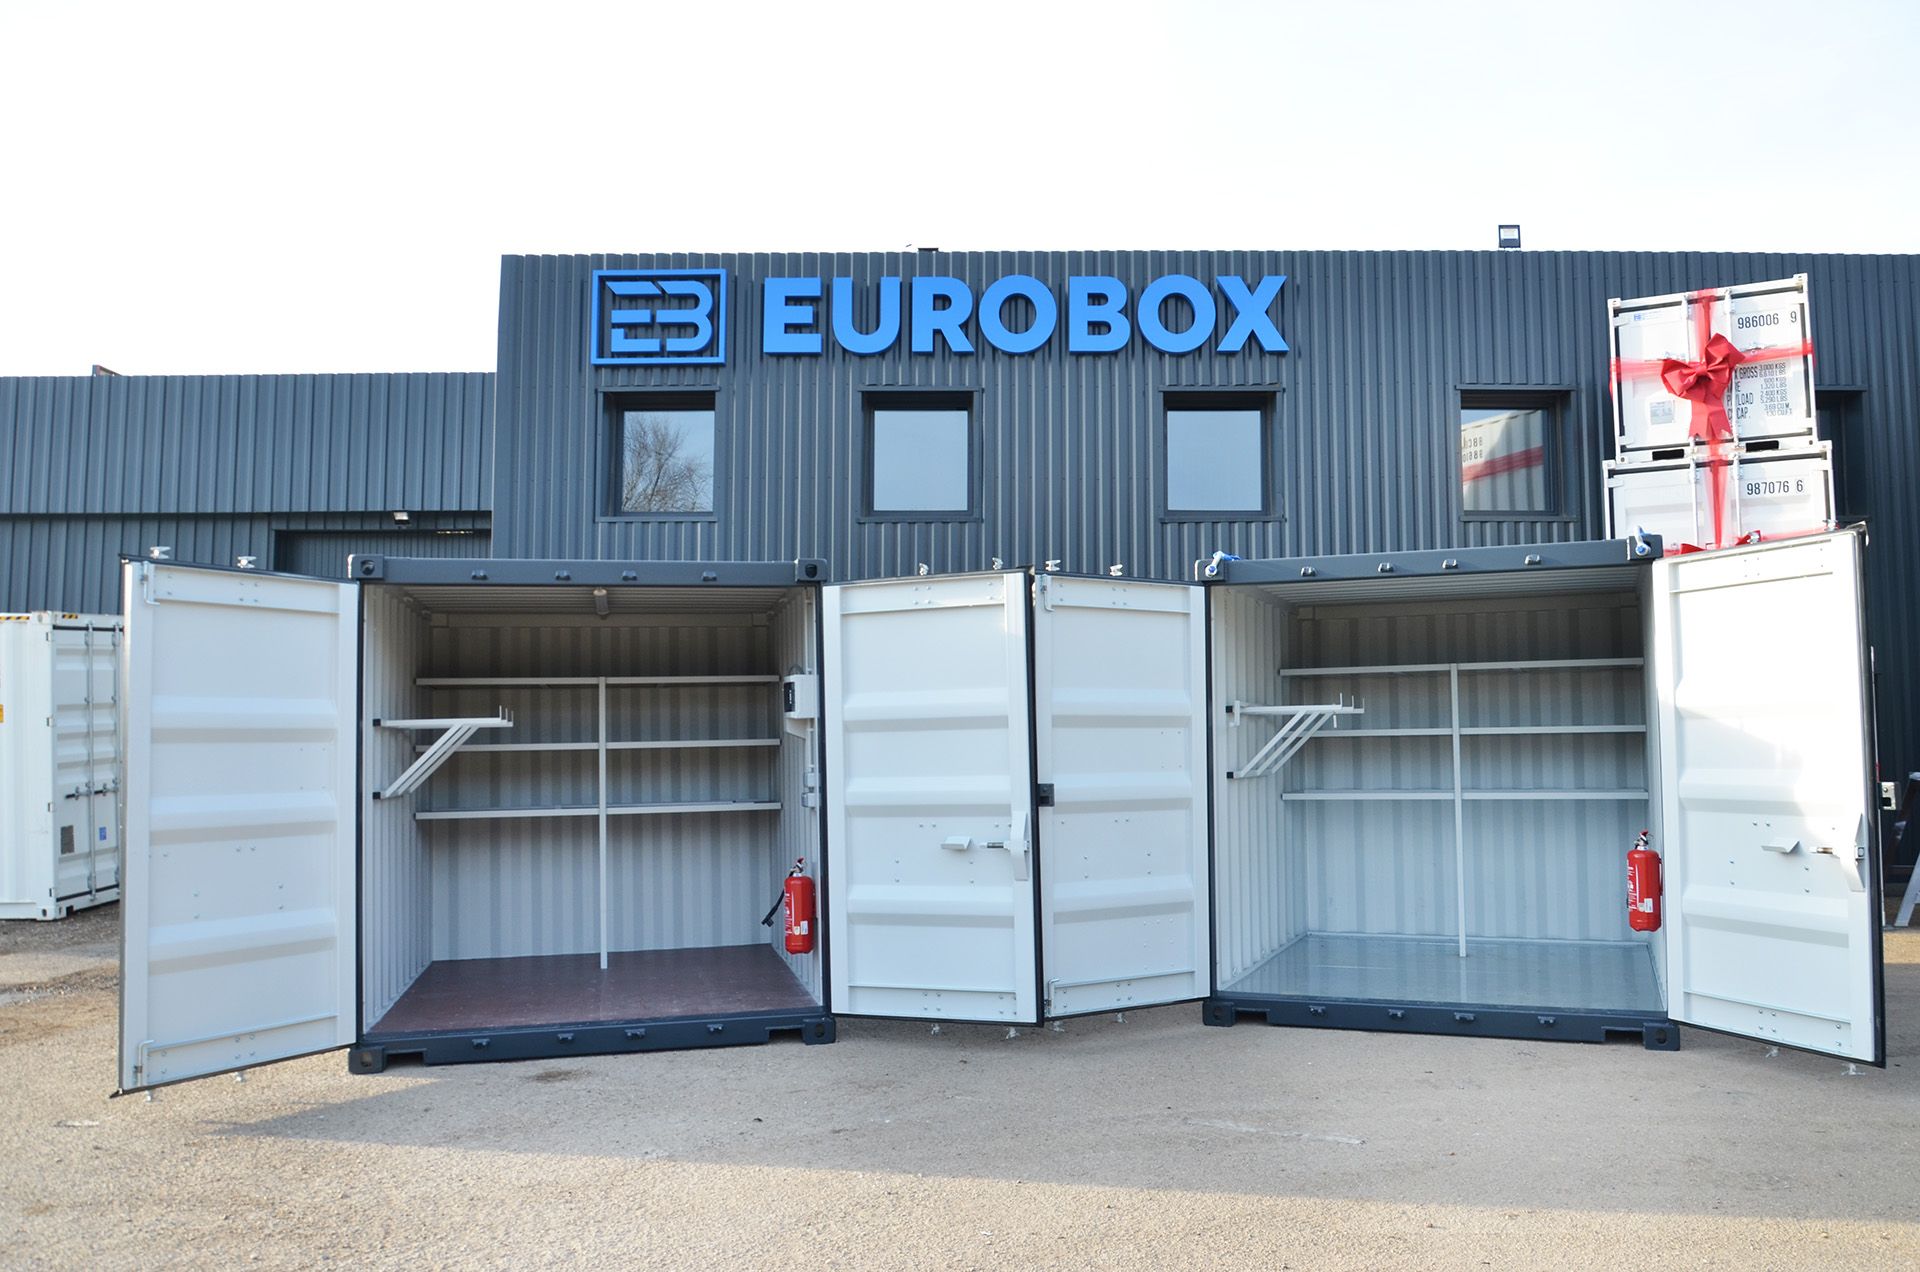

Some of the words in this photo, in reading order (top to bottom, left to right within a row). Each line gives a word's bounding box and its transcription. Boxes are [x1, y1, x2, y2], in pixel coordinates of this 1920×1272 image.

[763, 274, 1289, 355] EUROBOX
[1737, 313, 1779, 329] 986006
[1790, 310, 1797, 323] 9
[1746, 480, 1790, 496] 987076
[1796, 479, 1803, 493] 6
